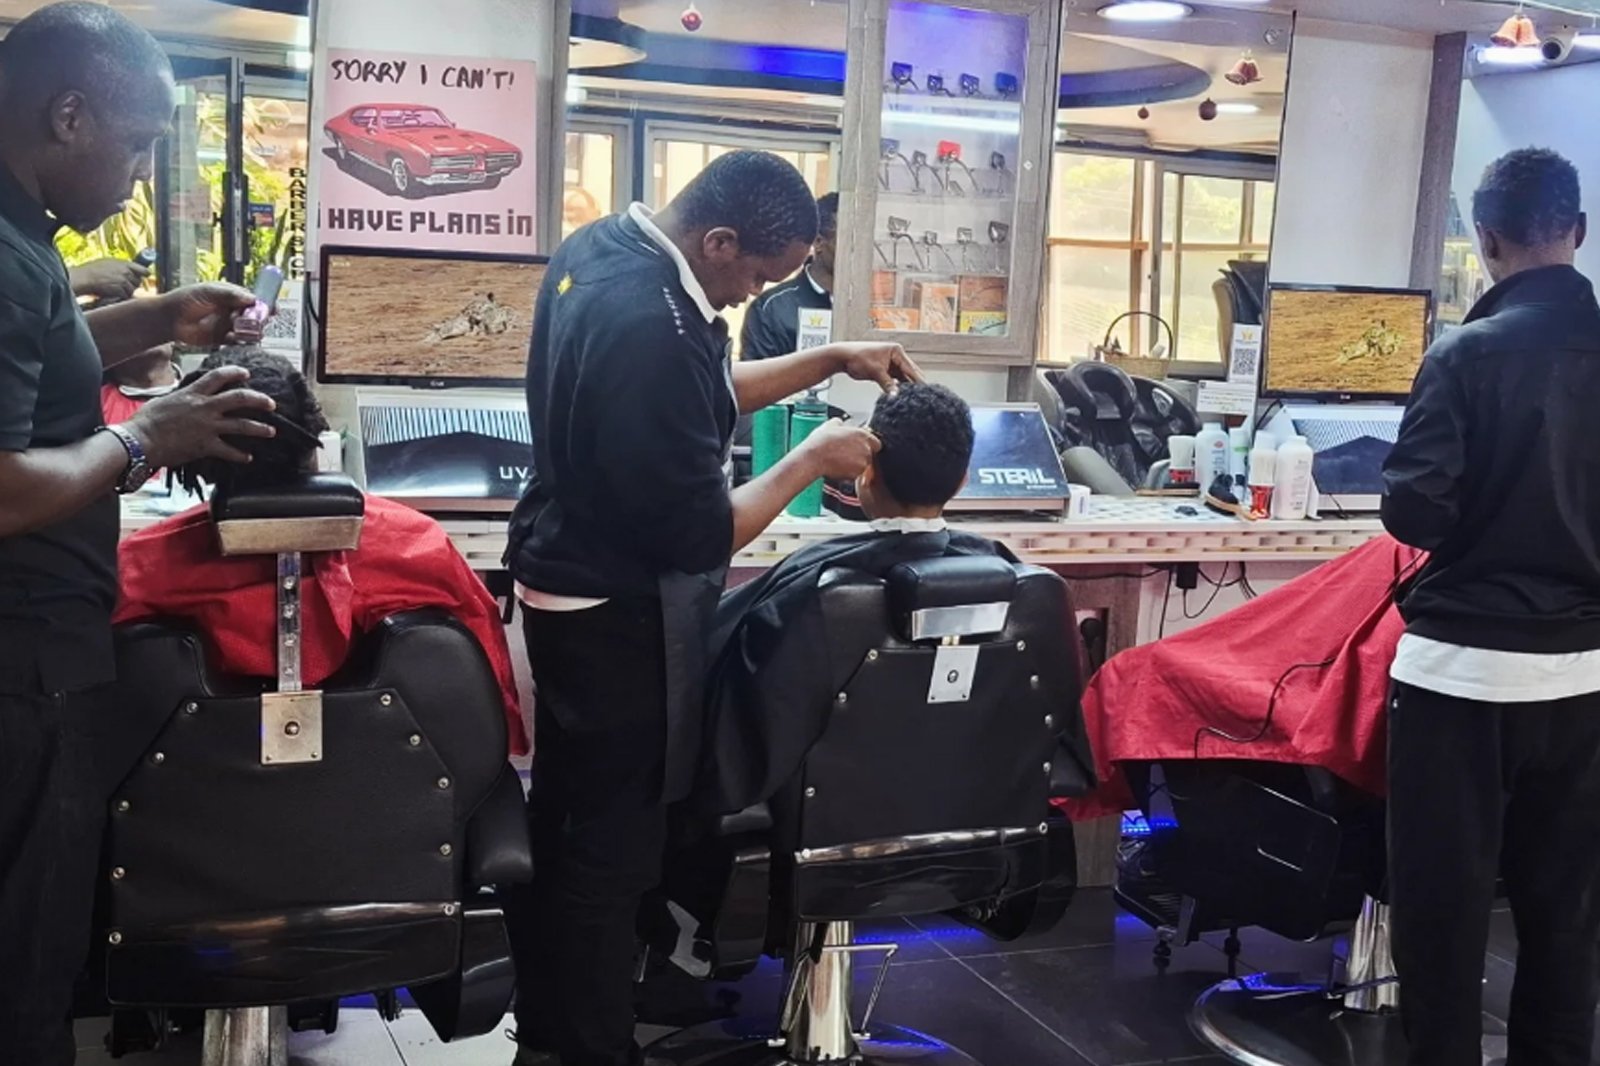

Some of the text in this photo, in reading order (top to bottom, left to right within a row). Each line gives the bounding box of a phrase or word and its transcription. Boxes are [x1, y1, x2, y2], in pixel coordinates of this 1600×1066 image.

[331, 59, 515, 91] SORRY I CAN'T!
[328, 208, 402, 232] HAVE
